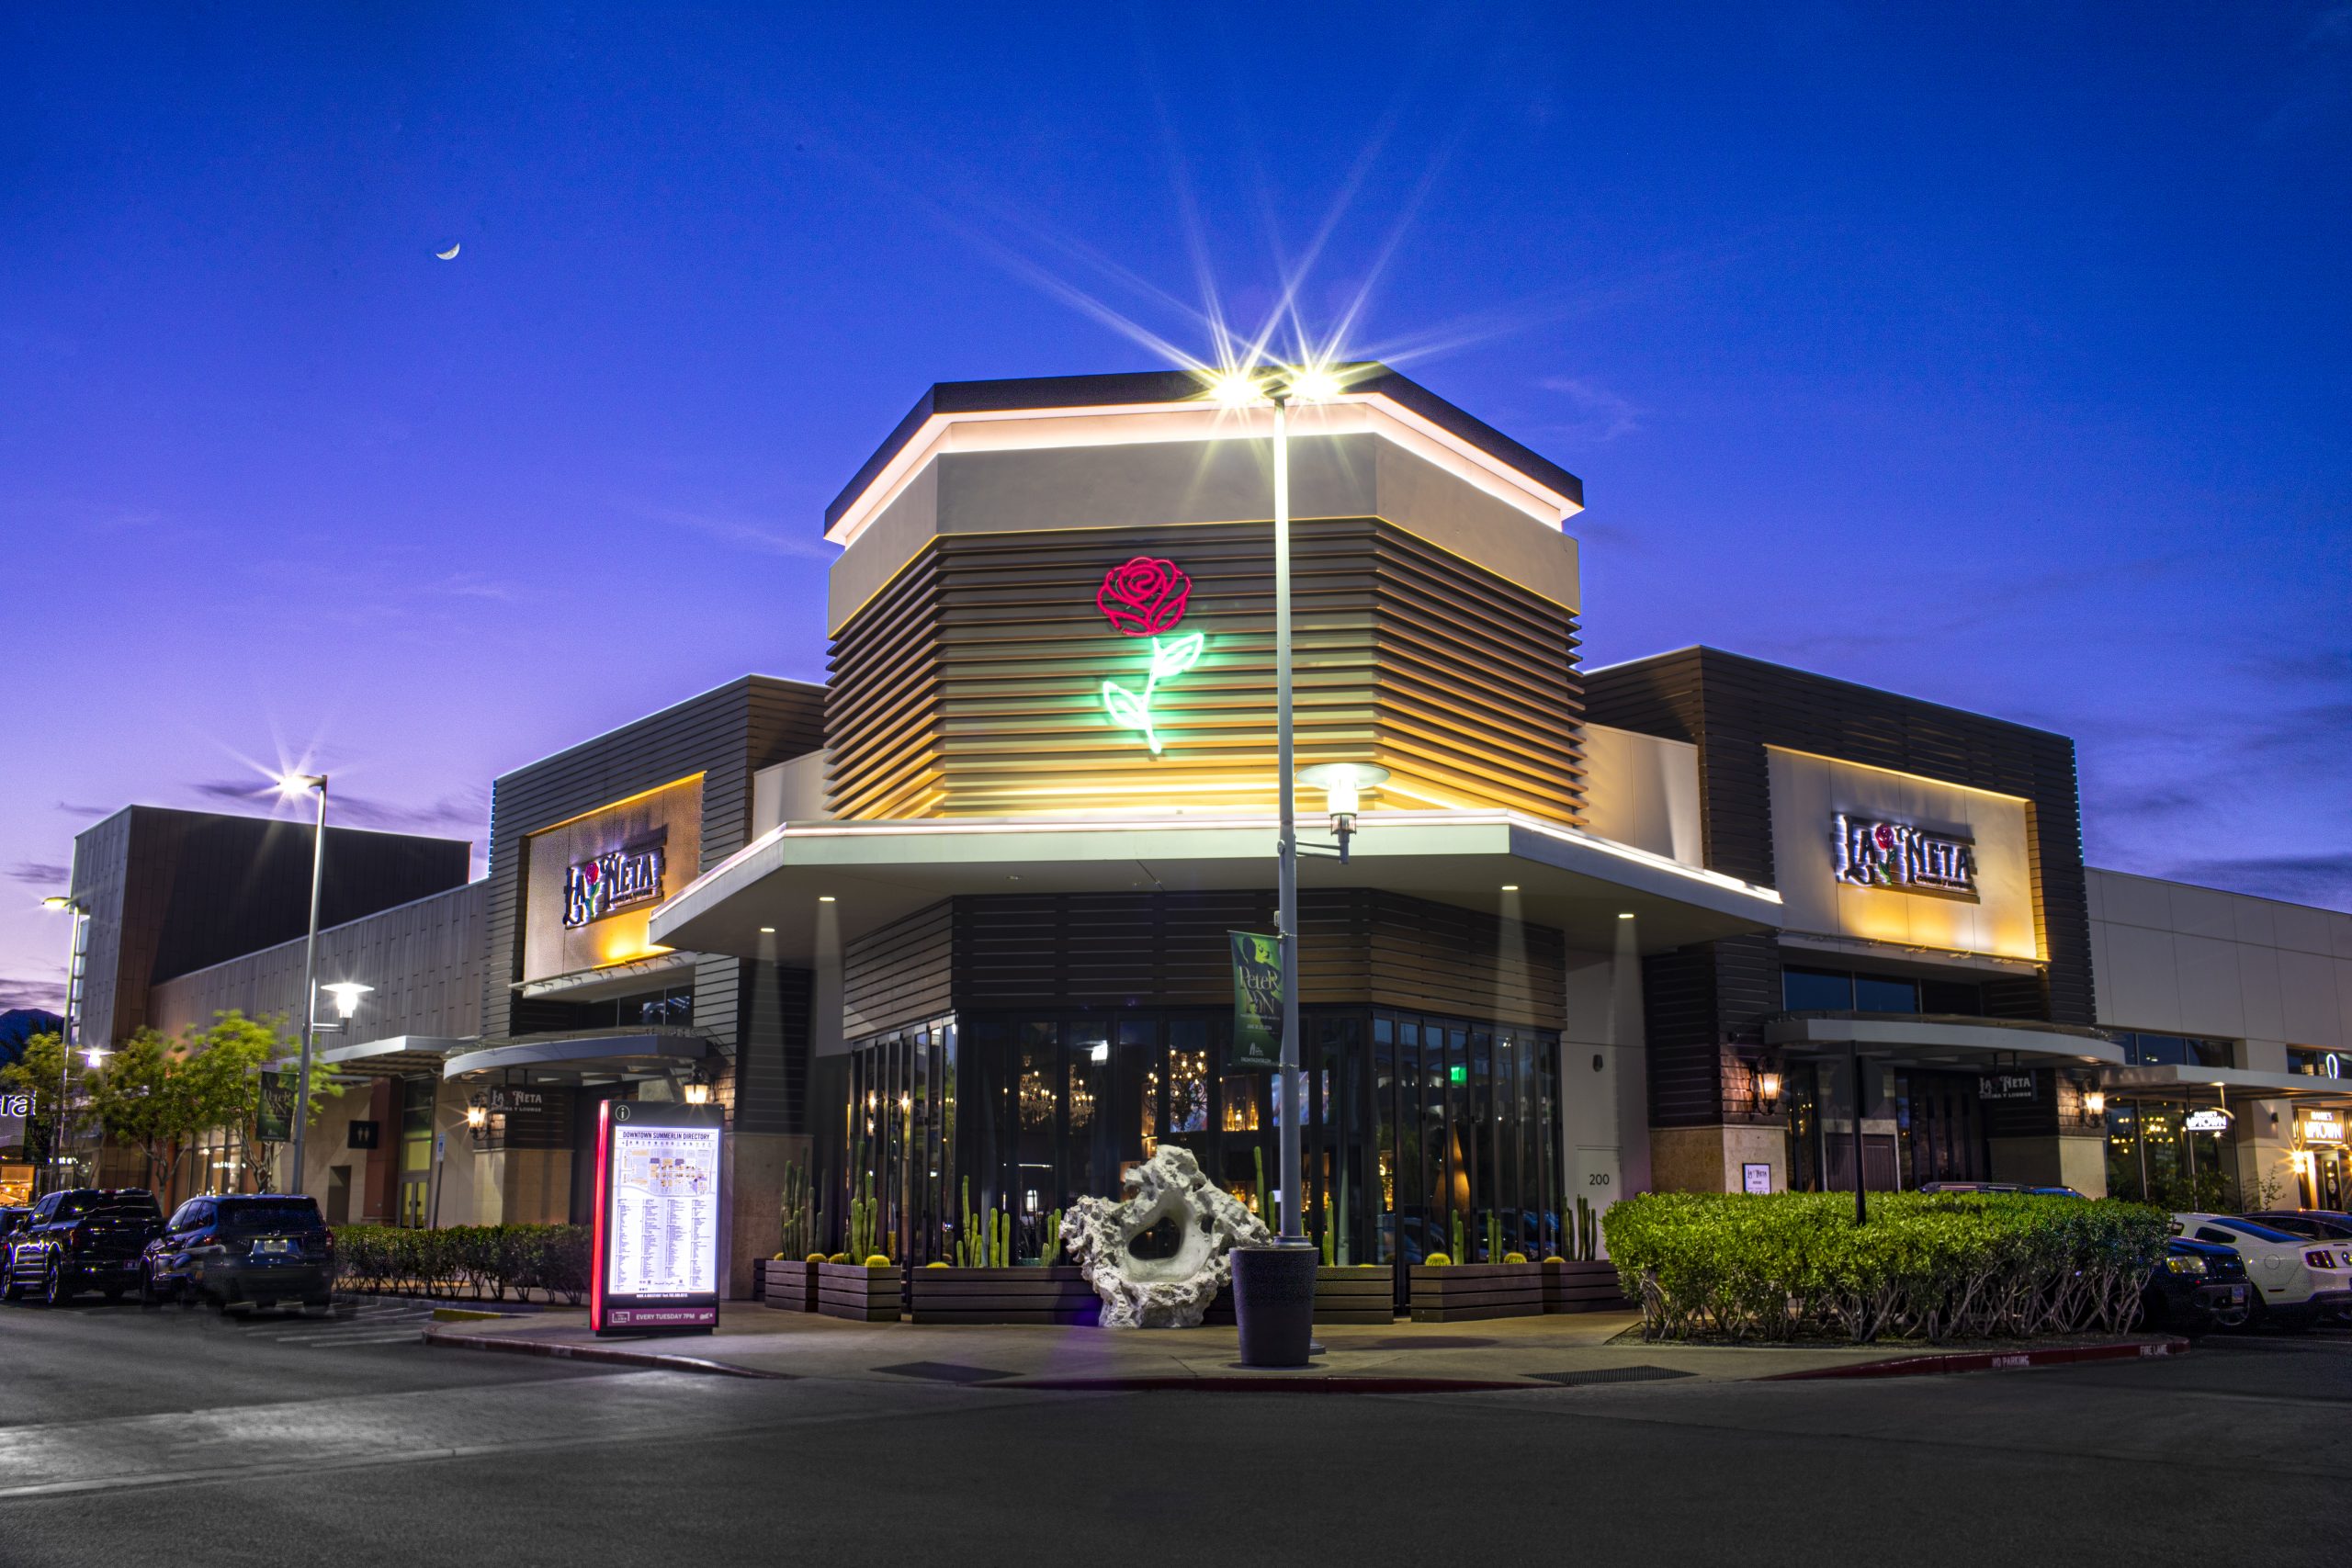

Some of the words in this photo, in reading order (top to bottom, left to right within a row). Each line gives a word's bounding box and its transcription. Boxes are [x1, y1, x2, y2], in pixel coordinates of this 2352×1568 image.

[623, 1131, 652, 1139] DOWNTOWN
[1589, 1174, 1610, 1185] 200
[1992, 1356, 2001, 1367] NO
[2002, 1355, 2030, 1367] PARKING
